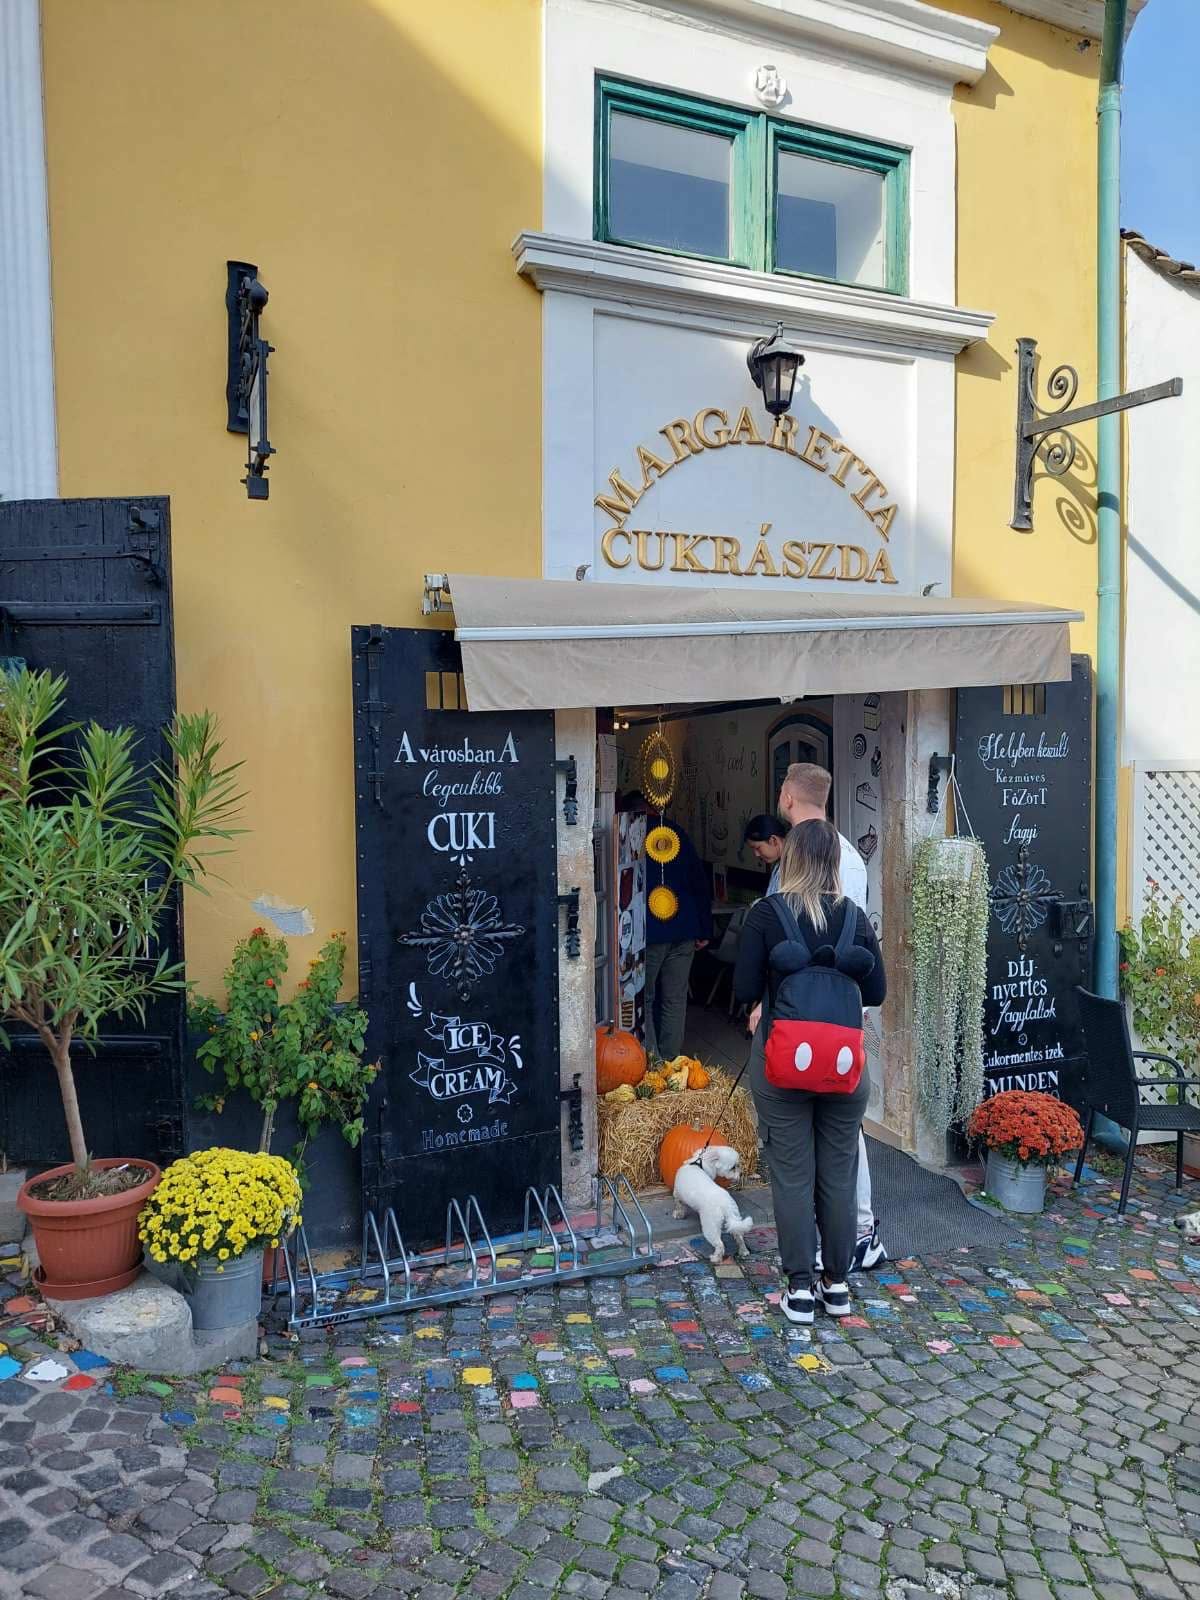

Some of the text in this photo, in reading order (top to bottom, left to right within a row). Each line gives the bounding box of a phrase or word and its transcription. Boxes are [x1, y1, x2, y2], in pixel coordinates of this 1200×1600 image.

[594, 406, 898, 542] MARGARETTA
[601, 523, 899, 584] CUKRÁSZDA
[394, 730, 520, 764] A városban A
[978, 731, 1035, 768] Helyben
[423, 769, 502, 807] legcukibb
[427, 812, 496, 851] CUKI
[1003, 813, 1038, 845] fagyi
[992, 978, 1048, 1007] nyertes
[991, 997, 1057, 1035] fagylaltok
[447, 1024, 487, 1050] ICE
[982, 1045, 1043, 1068] Cukormentes
[431, 1067, 502, 1097] CREAM
[988, 1070, 1059, 1098] MINDEN
[422, 1120, 509, 1150] Homemade
